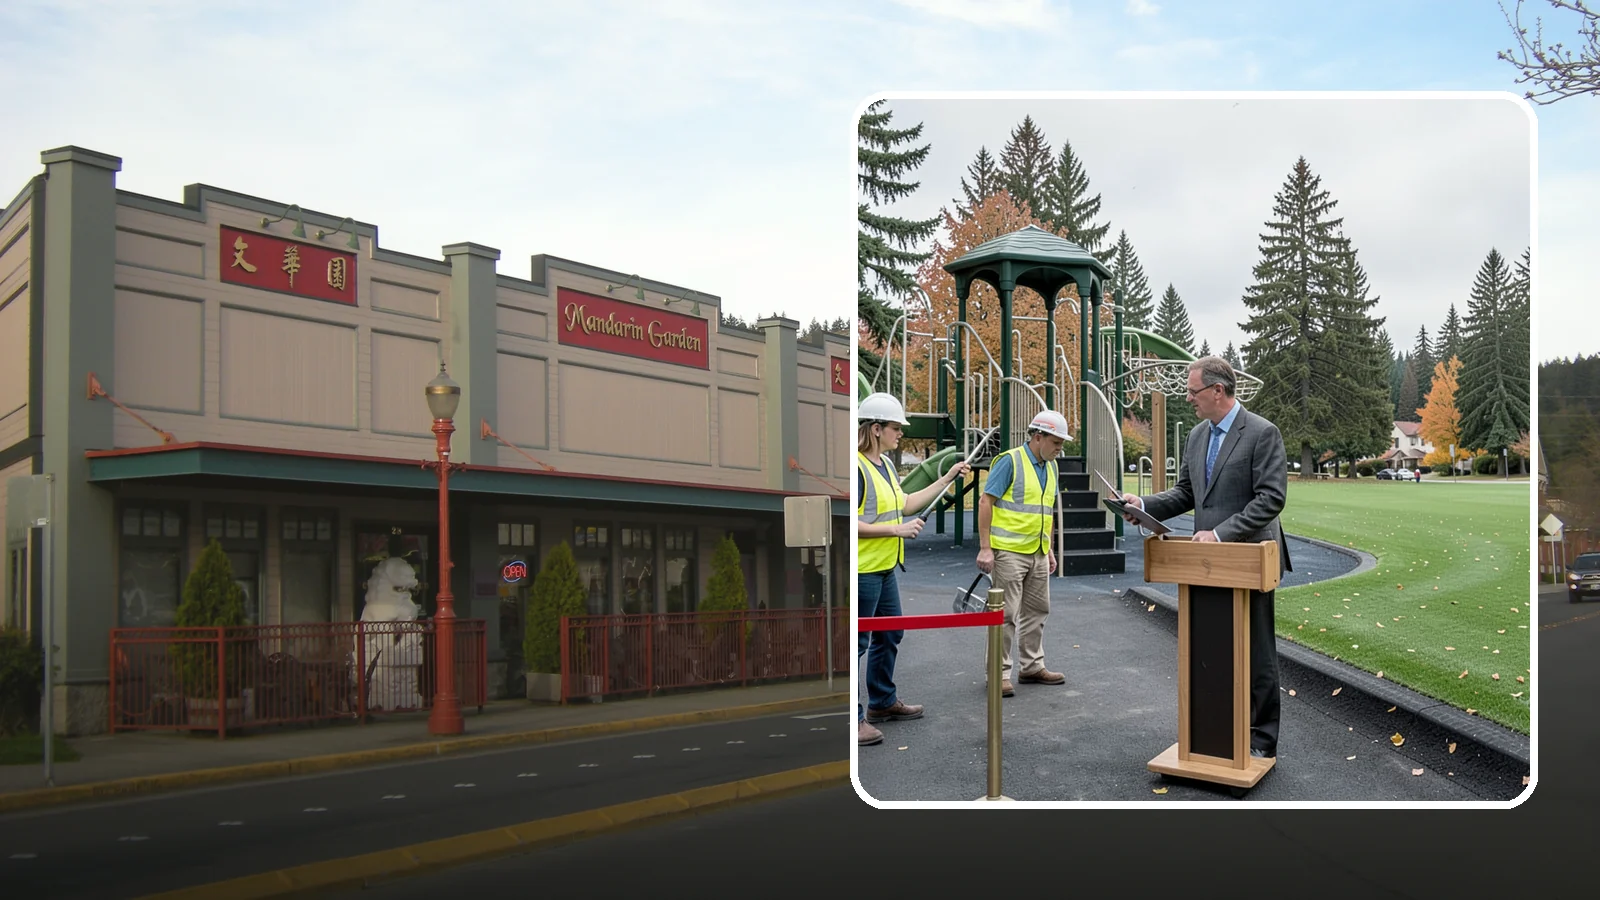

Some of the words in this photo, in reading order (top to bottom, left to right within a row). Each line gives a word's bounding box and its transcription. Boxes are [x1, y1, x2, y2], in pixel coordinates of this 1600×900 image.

[230, 235, 346, 291] 文華園
[564, 302, 644, 341] Mandarin
[648, 320, 701, 352] Garden
[503, 565, 527, 578] OPEN
